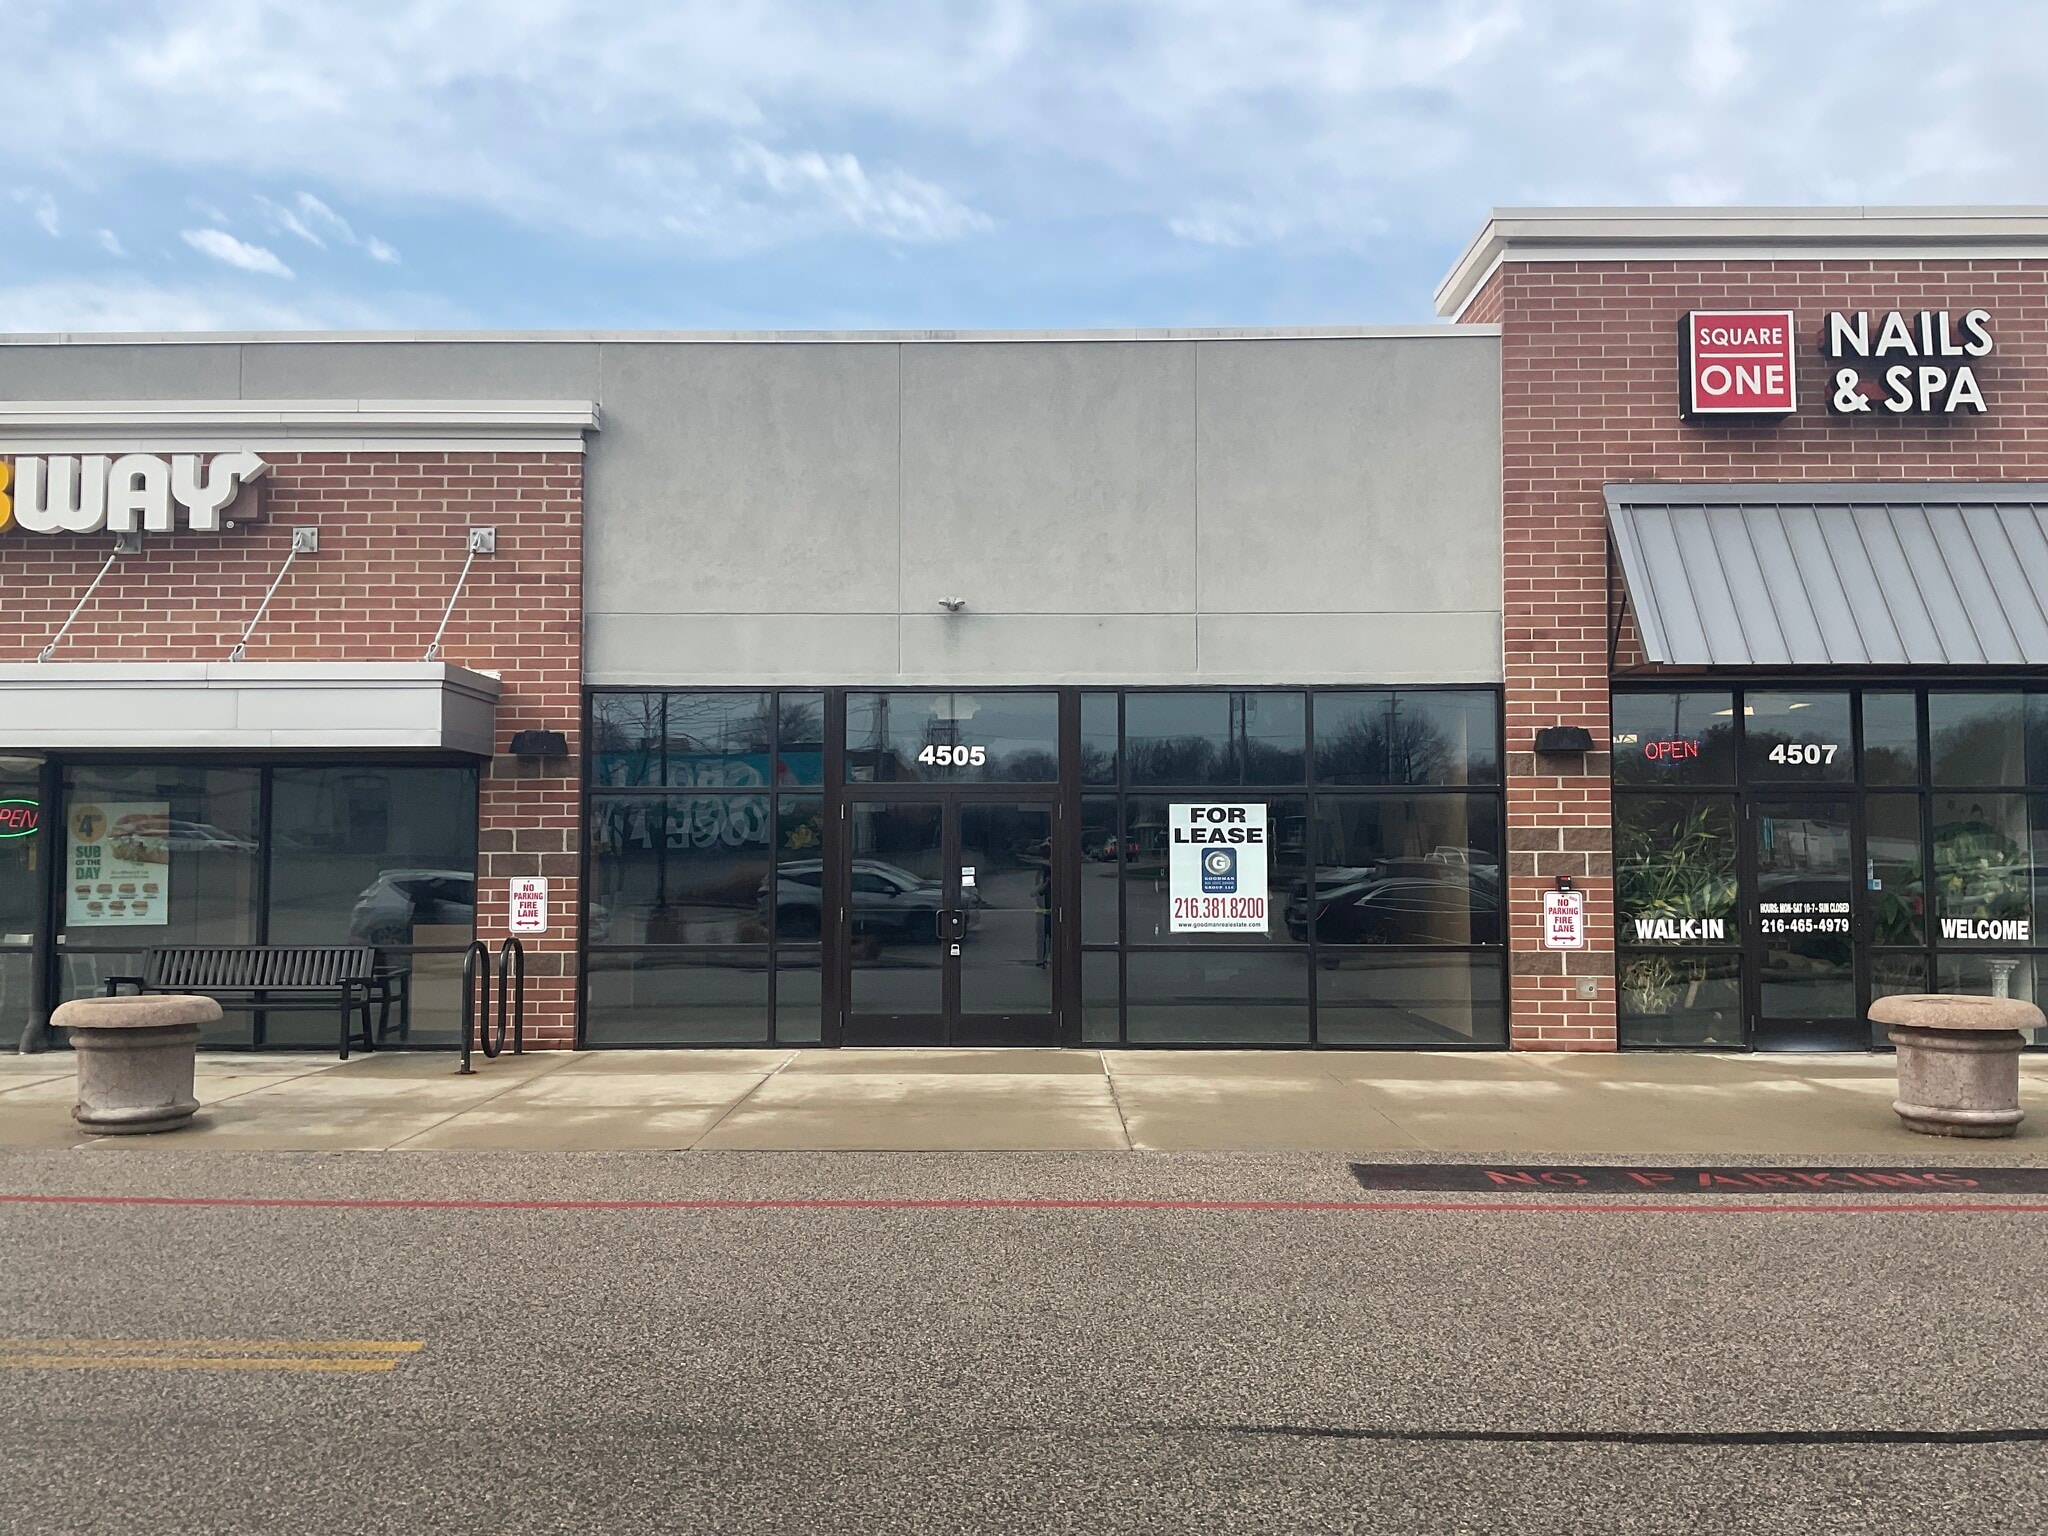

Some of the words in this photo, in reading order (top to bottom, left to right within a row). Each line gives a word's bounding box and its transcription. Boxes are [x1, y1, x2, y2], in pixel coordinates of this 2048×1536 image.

[1700, 327, 1783, 347] SQUARE
[1830, 309, 1994, 357] NAILS
[1700, 365, 1784, 396] ONE
[1833, 367, 1872, 413] &
[1883, 365, 1988, 413] SPA
[918, 745, 986, 766] 4505
[1645, 740, 1699, 759] OPEN
[1768, 744, 1838, 765] 4507
[1190, 807, 1246, 823] FOR
[1174, 827, 1263, 844] LEASE
[75, 845, 101, 858] SUB
[75, 866, 101, 880] DAY
[514, 892, 543, 900] PARKING
[519, 901, 537, 909] FIRE
[1174, 897, 1264, 919] 216.381.8200
[1548, 907, 1578, 915] PARKING
[1760, 903, 1779, 913] HOURS:
[1779, 903, 1803, 913] MON-SAT
[1818, 903, 1829, 913] SUN
[1829, 902, 1849, 913] CLOSED
[1554, 916, 1573, 924] FIRE
[1635, 918, 1724, 940] WALK-IN
[1761, 918, 1849, 933] 216-465-4979
[1940, 918, 2029, 941] WELCOME
[1484, 1170, 1588, 1187] NO
[1624, 1170, 1981, 1188] PARKING
